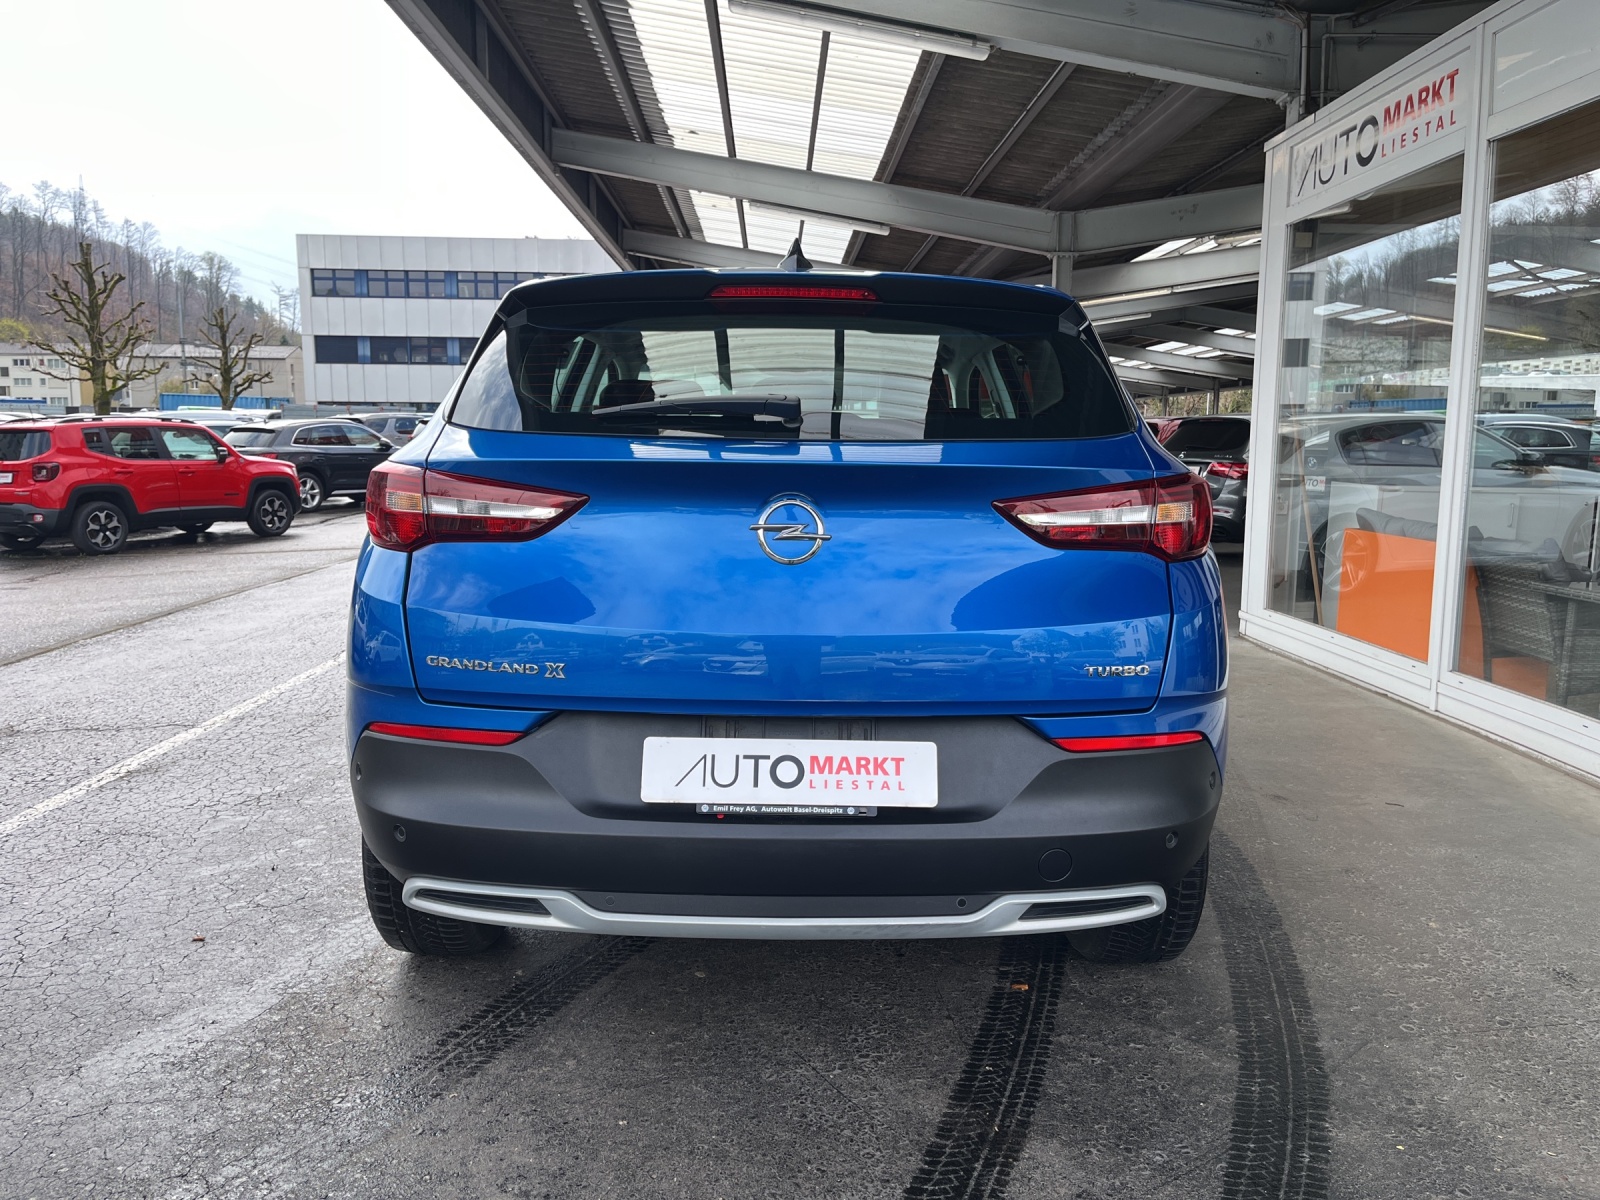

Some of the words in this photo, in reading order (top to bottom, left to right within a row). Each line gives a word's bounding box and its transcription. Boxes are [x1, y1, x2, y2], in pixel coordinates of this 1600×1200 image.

[1297, 115, 1379, 197] AUTO
[1383, 68, 1459, 135] MARKT
[1381, 110, 1457, 158] LIESTAL
[425, 655, 539, 675] GRANDLAND
[544, 662, 566, 679] X
[1084, 665, 1150, 677] TURBO
[675, 754, 805, 789] AUTO
[809, 755, 905, 777] MARKT
[809, 779, 906, 791] LIESTAL
[729, 805, 744, 813] Frey
[745, 805, 758, 813] AG,
[793, 806, 843, 815] Basel-Dreispitz
